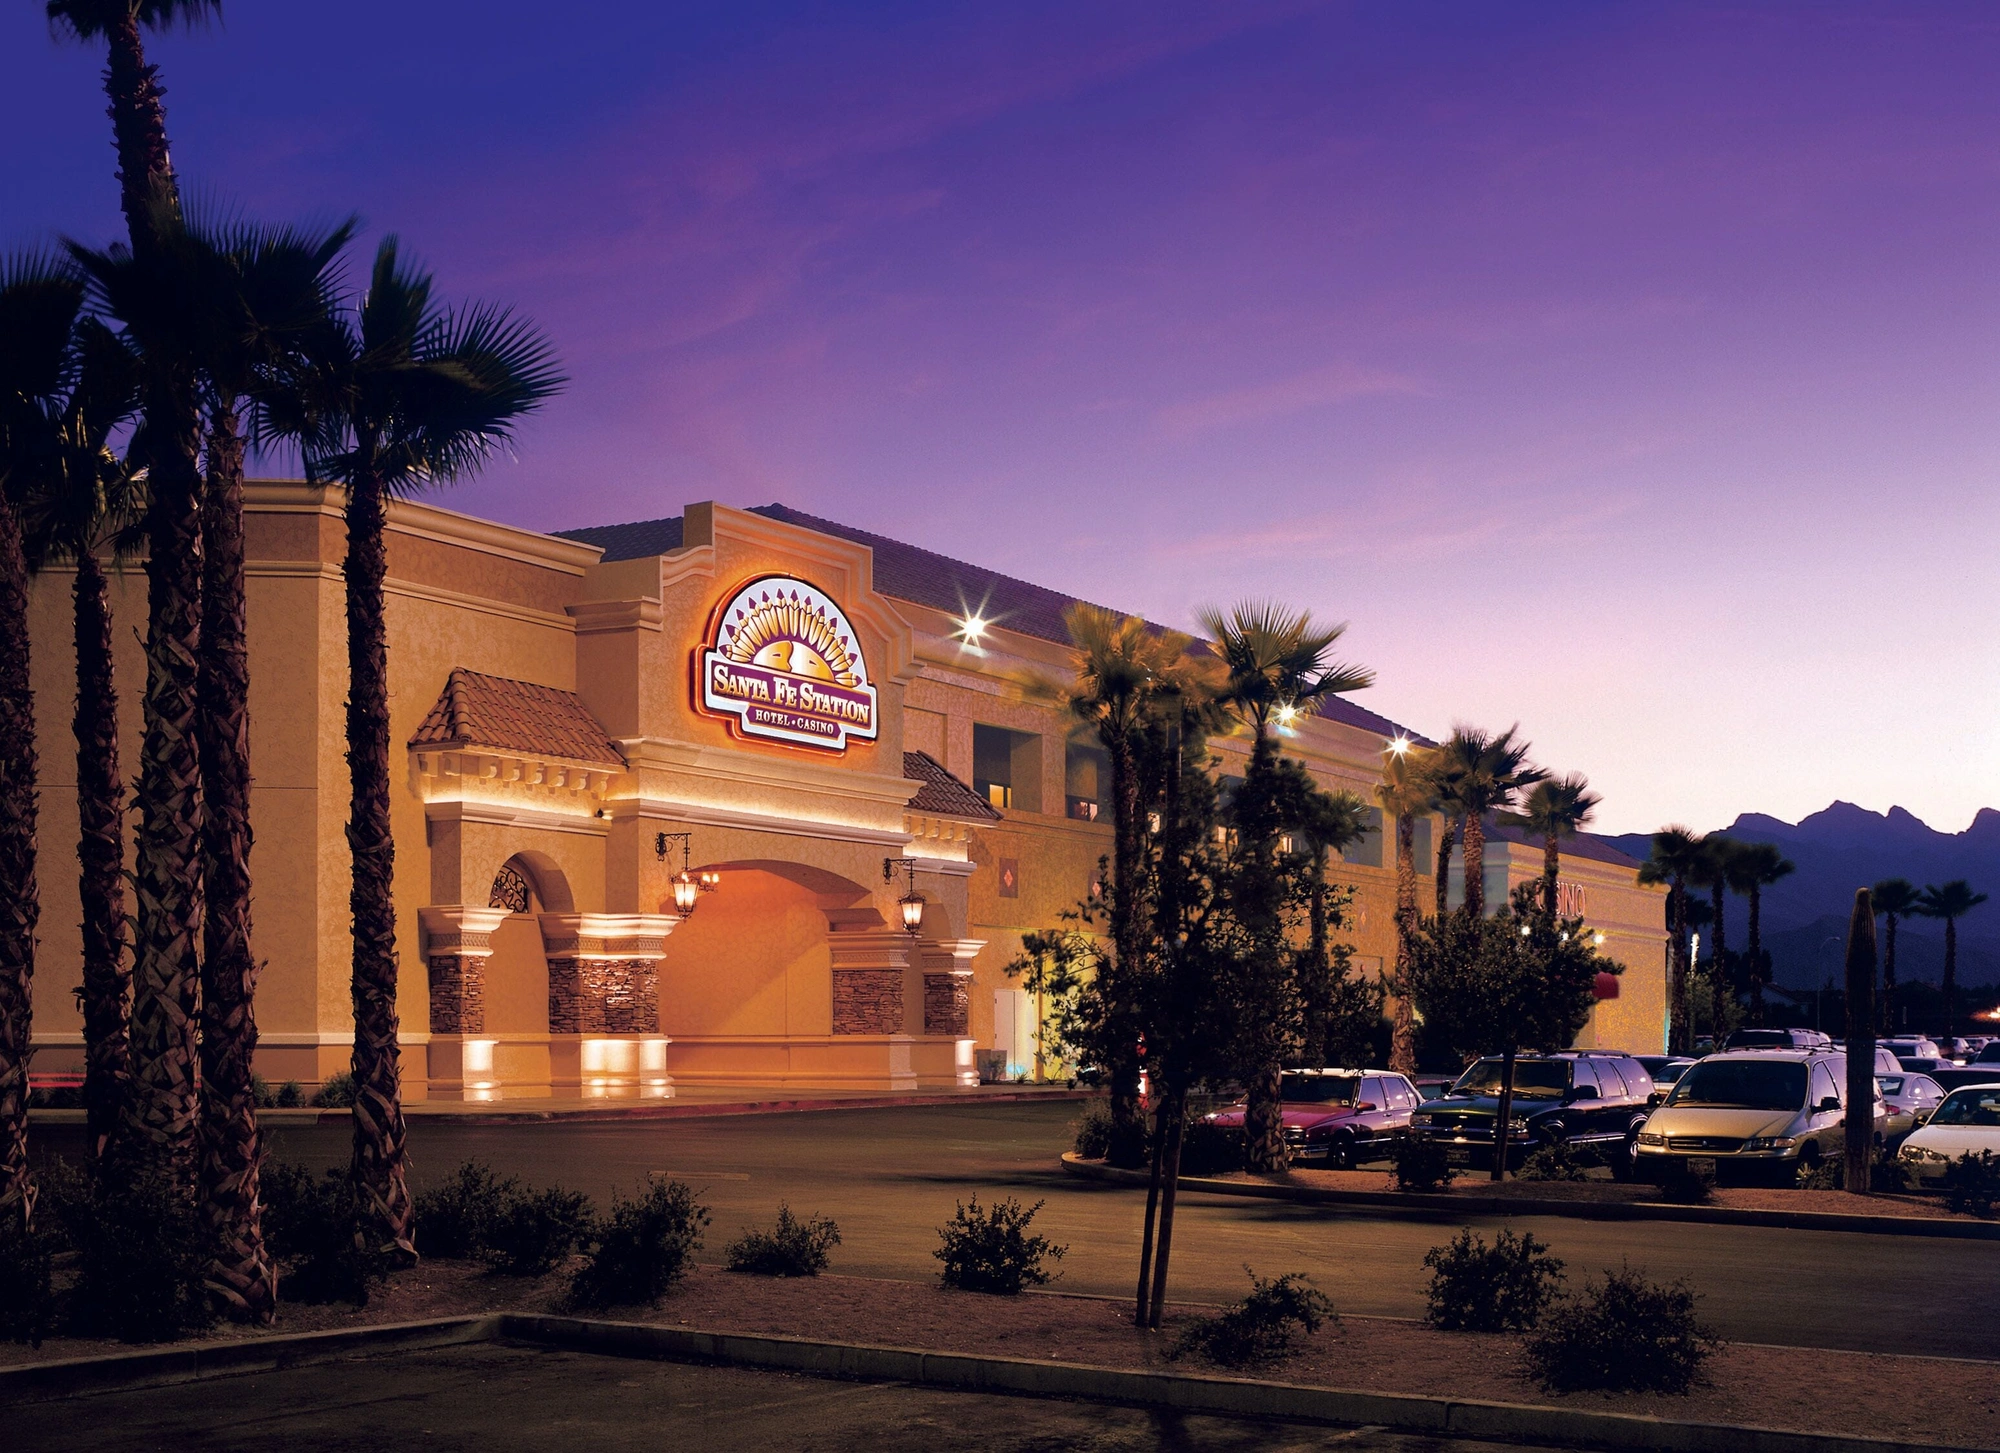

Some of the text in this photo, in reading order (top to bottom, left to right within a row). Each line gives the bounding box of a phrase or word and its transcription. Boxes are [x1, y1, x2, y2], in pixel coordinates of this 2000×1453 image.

[713, 665, 870, 723] SANTA FE STATION
[755, 709, 834, 734] HOTEL CASINO
[1535, 880, 1586, 918] CSINO
